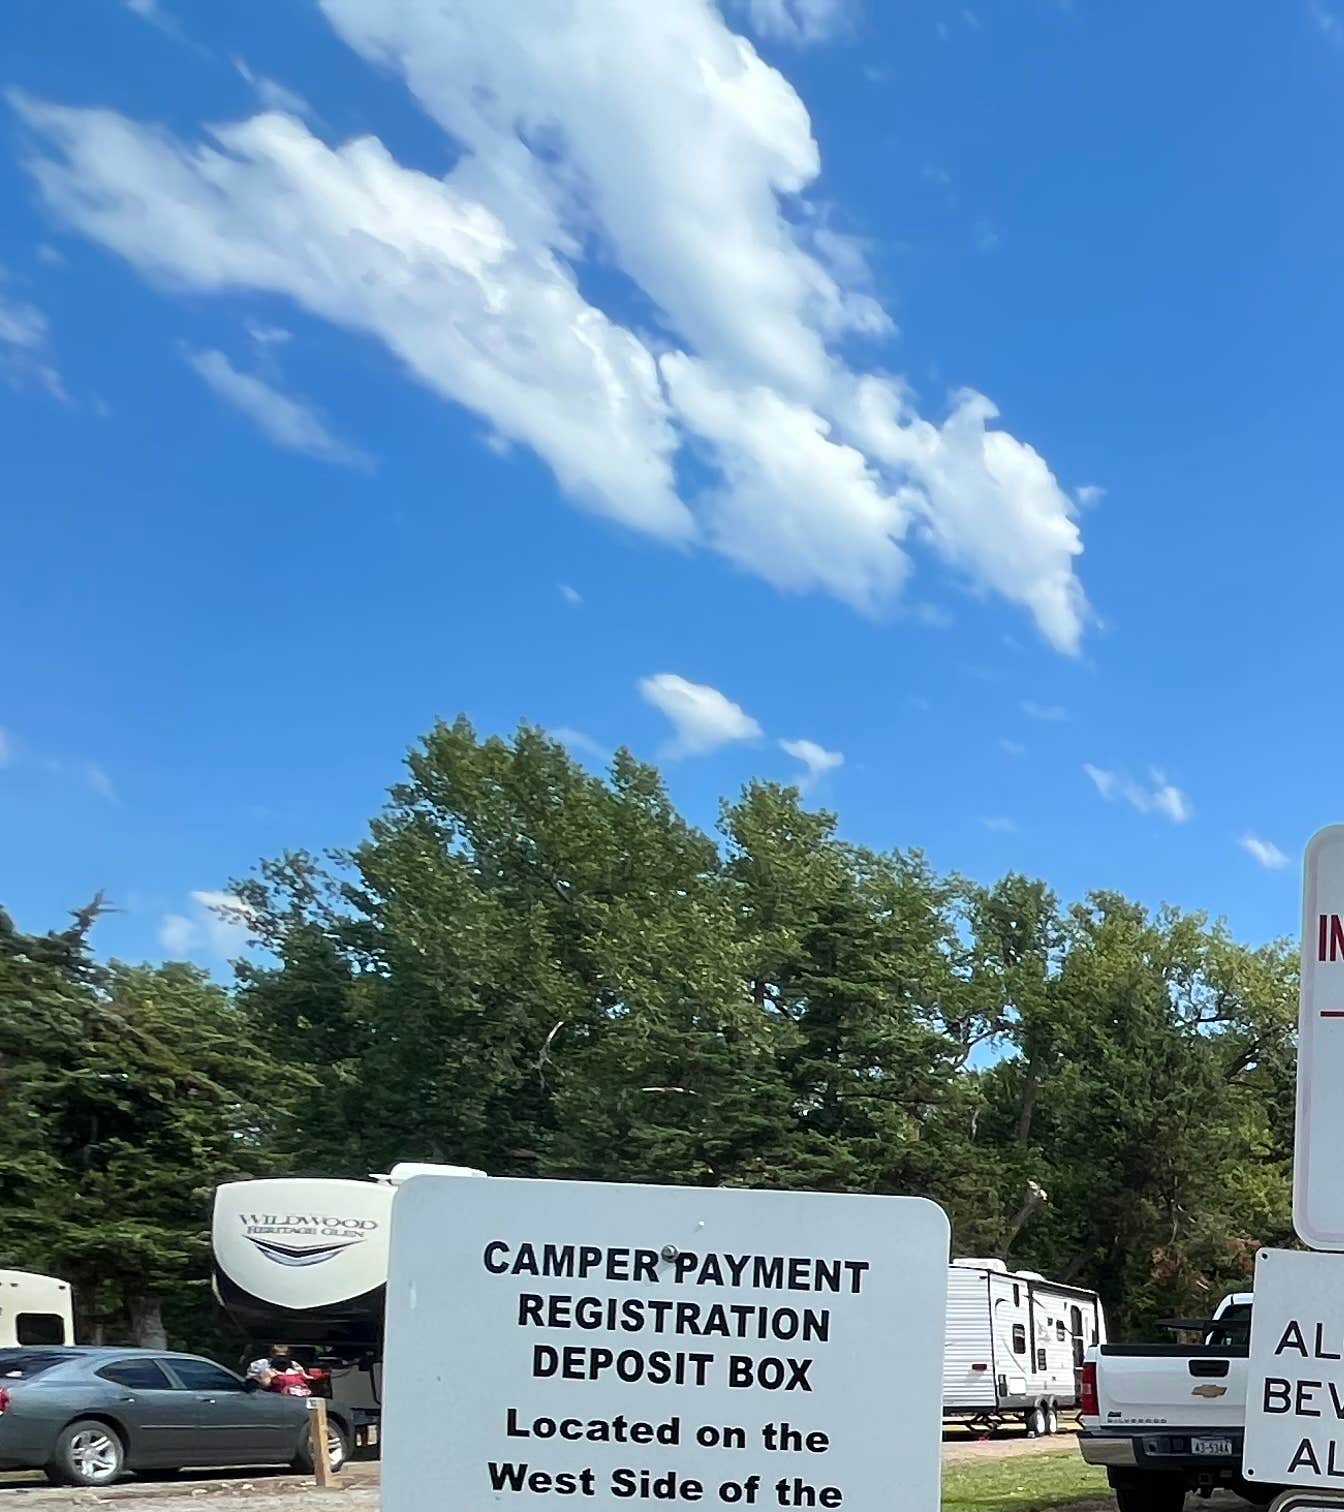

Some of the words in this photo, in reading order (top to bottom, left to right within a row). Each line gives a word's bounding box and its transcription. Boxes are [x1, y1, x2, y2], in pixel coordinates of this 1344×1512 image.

[239, 1214, 378, 1230] WILDWOOD
[247, 1226, 317, 1234] HERITAGE
[321, 1228, 365, 1237] GLEN
[484, 1241, 659, 1282] CAMPER
[675, 1250, 869, 1293] PAYMENT
[519, 1294, 829, 1341] REGISTRATION
[533, 1345, 714, 1385] DEPOSIT
[729, 1356, 812, 1391] BOX
[507, 1409, 679, 1444] Located
[697, 1426, 745, 1448] on
[762, 1423, 829, 1452] the
[488, 1462, 595, 1495] West
[611, 1469, 703, 1500] Side
[719, 1476, 760, 1503] of
[776, 1478, 842, 1508] the
